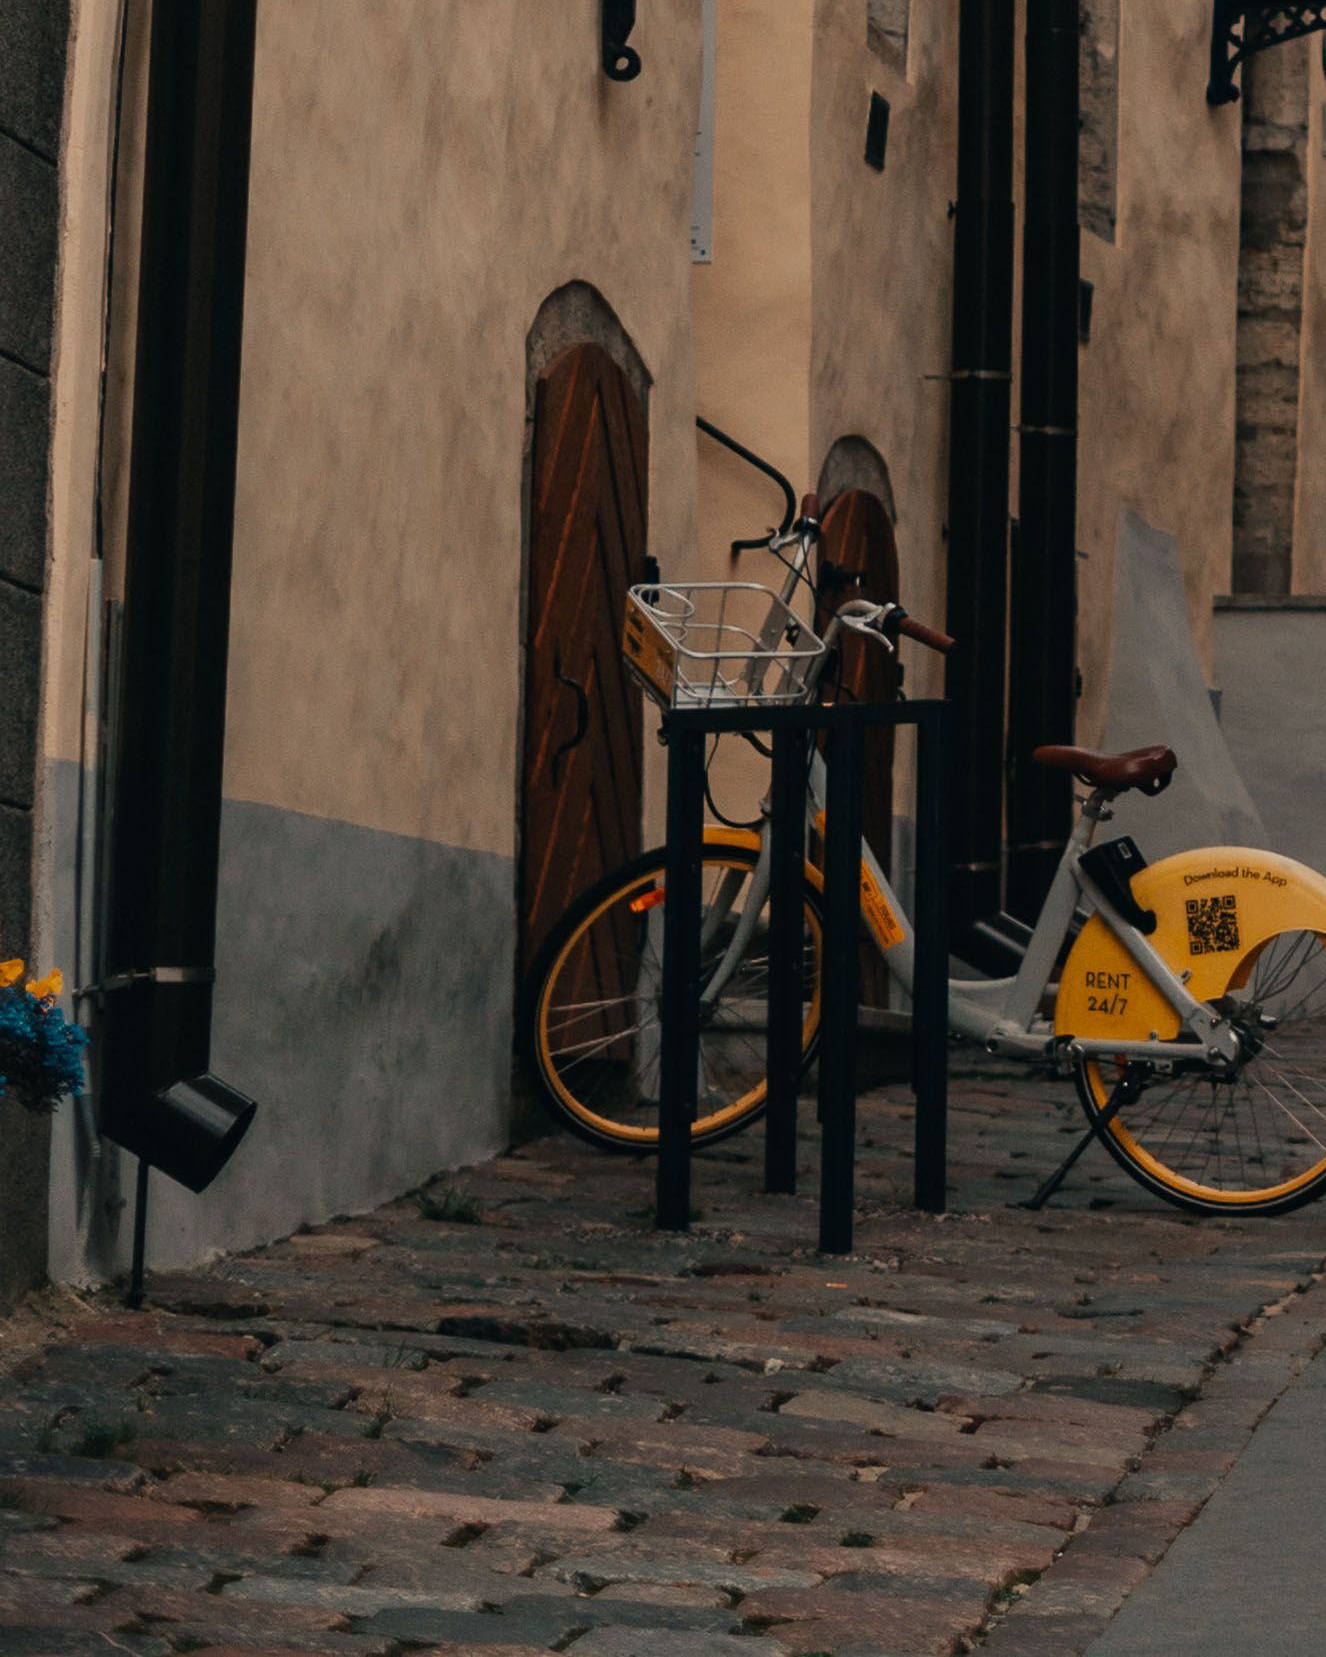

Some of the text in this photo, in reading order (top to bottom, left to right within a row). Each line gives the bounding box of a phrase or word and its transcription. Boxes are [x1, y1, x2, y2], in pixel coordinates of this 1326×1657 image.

[1184, 866, 1288, 888] Download the App
[1085, 971, 1131, 990] RENT
[1087, 993, 1128, 1015] 24/7
